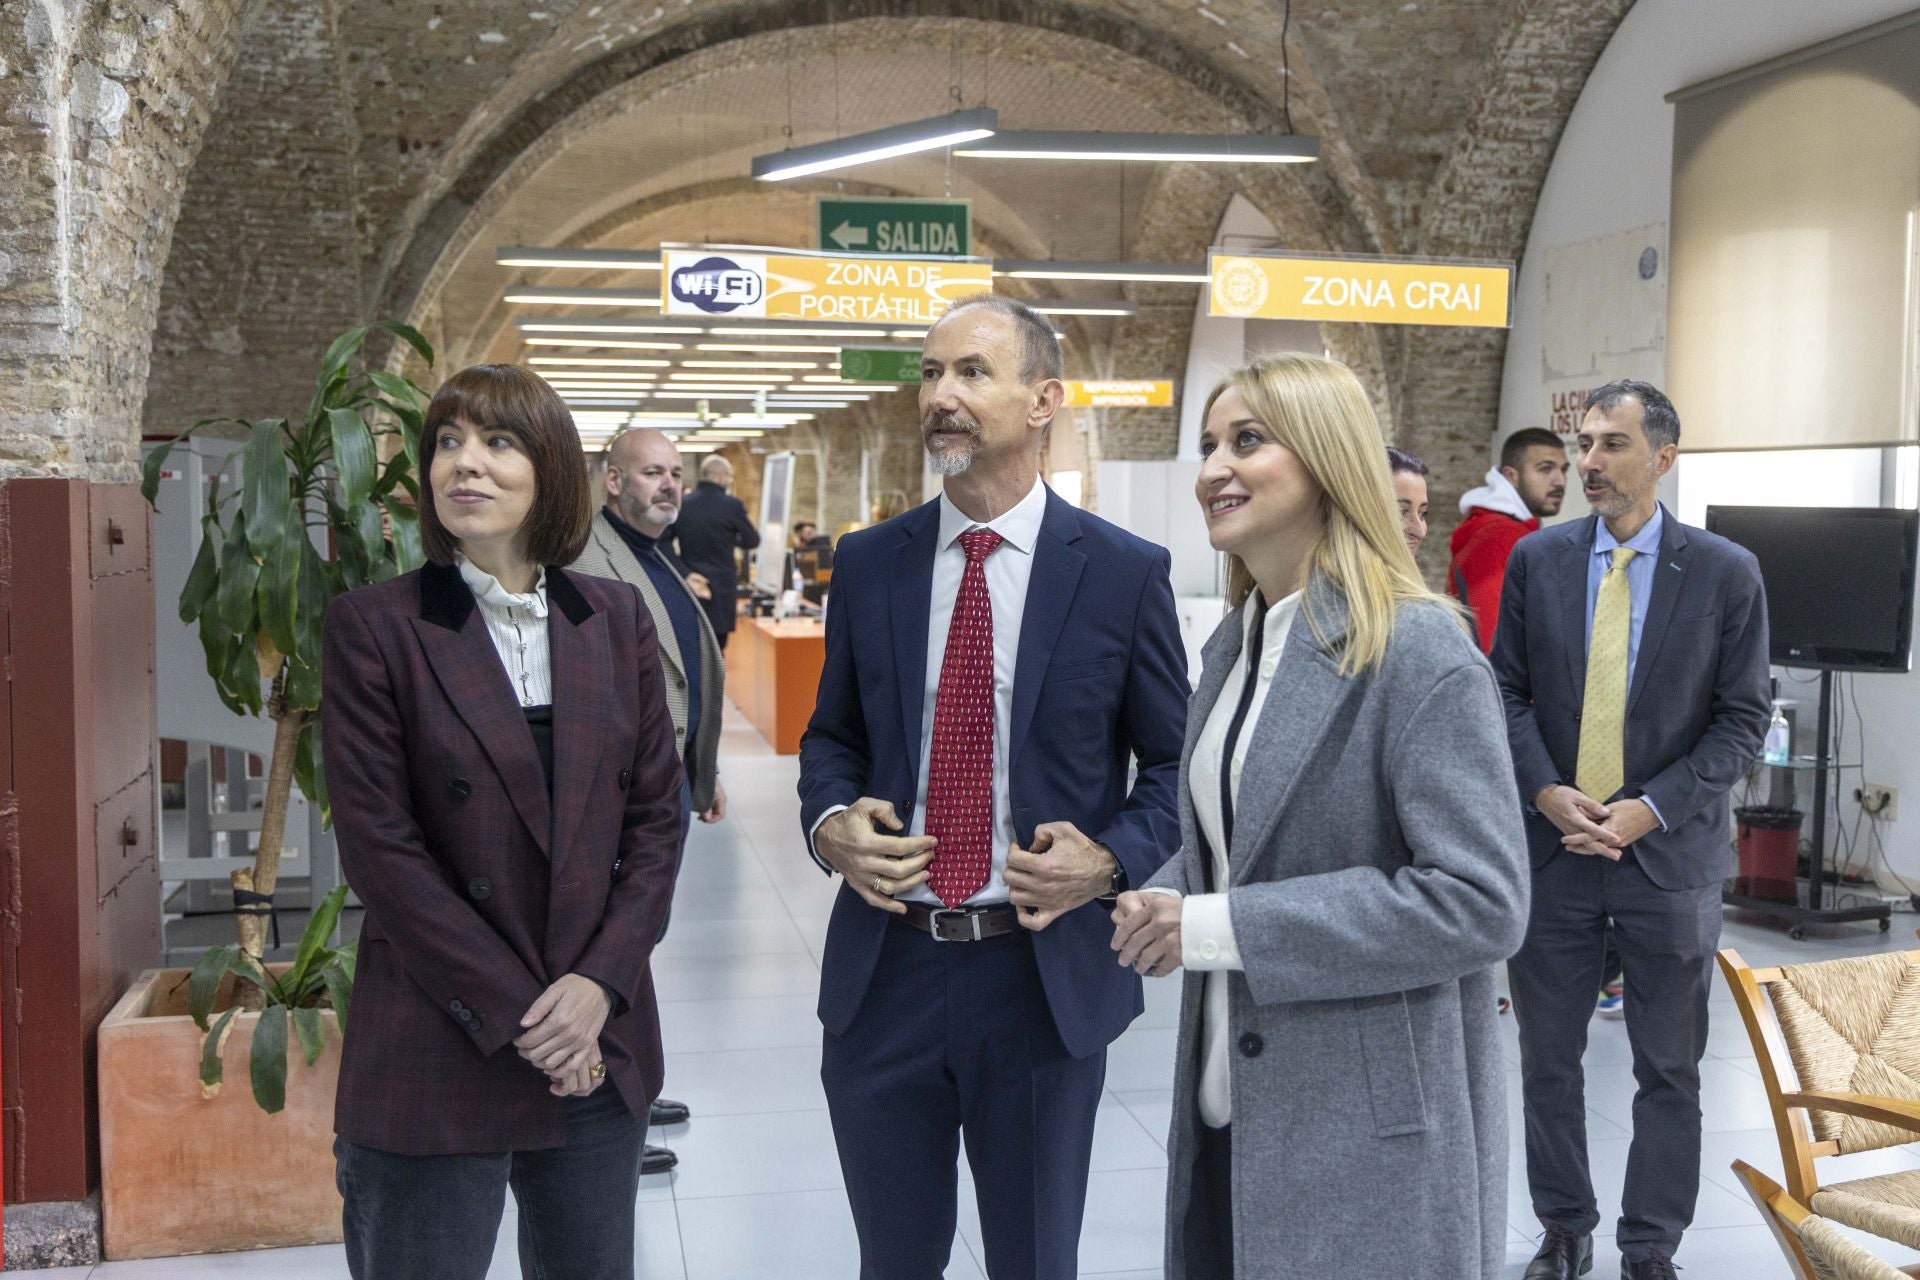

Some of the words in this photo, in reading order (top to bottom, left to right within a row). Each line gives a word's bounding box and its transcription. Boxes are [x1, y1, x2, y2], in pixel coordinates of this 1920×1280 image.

[877, 220, 960, 253] SALIDA
[825, 262, 899, 288] ZONA
[907, 266, 943, 289] DE
[799, 293, 949, 320] PORTÁTILE
[1301, 275, 1396, 309] ZONA
[1404, 280, 1481, 312] CRAI
[1552, 393, 1567, 412] LA
[1550, 413, 1571, 435] LOS
